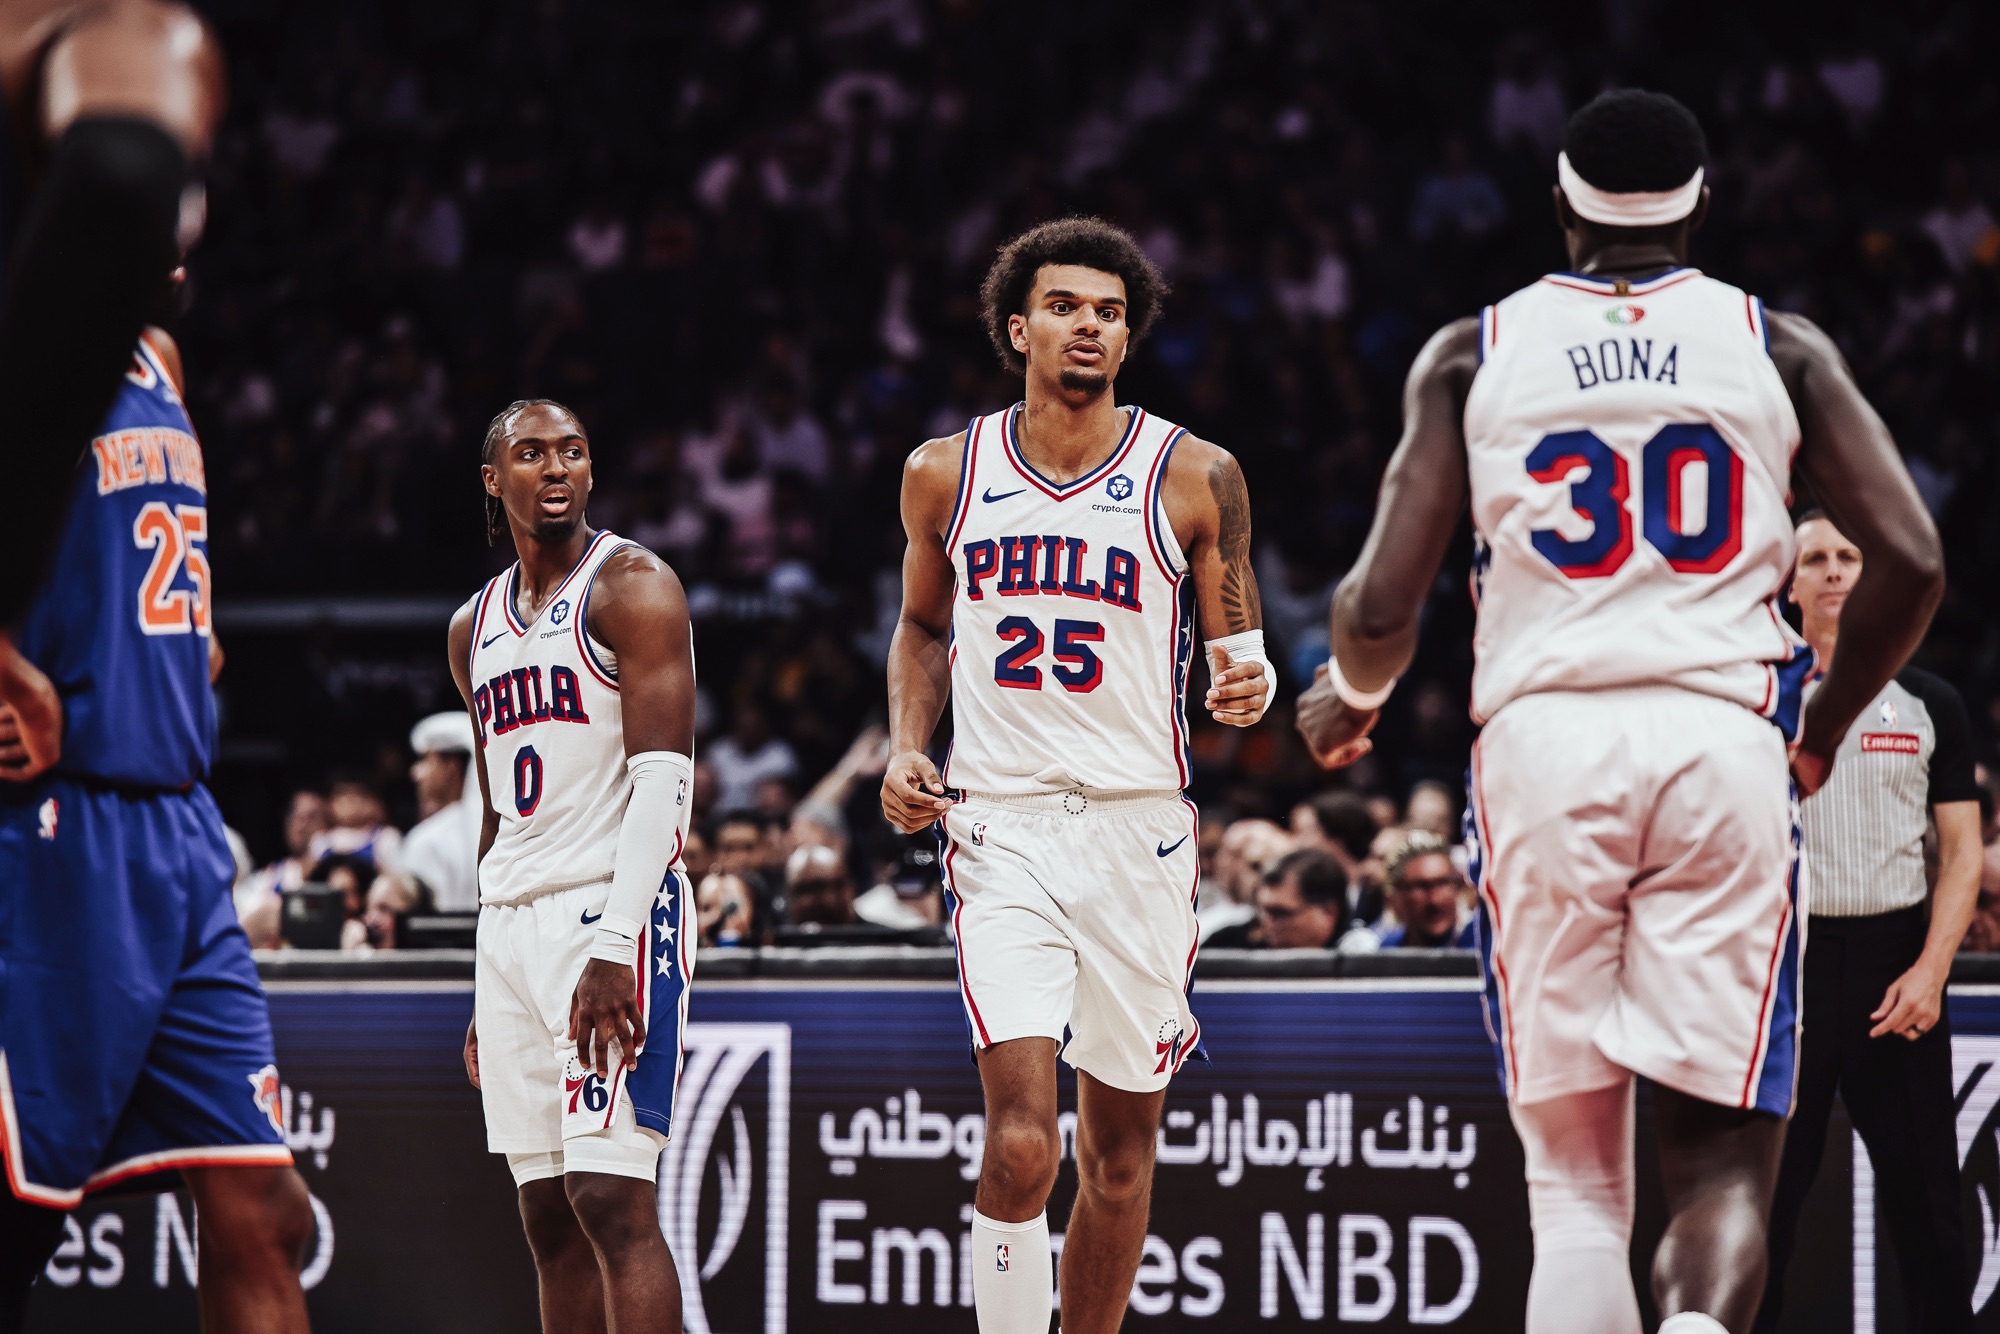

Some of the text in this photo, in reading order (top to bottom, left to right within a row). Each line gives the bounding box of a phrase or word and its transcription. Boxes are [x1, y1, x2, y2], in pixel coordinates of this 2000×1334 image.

[1566, 338, 1679, 390] BONA
[1091, 503, 1142, 515] crypto.com
[1525, 422, 1745, 579] 30
[133, 501, 211, 636] 25
[963, 535, 1143, 613] PHILA
[540, 626, 572, 640] crypto.com
[994, 615, 1105, 693] 25
[473, 664, 590, 749] PHILA
[1862, 734, 1919, 751] Emirates
[514, 744, 543, 817] 0
[565, 1072, 609, 1115] 76
[1360, 1094, 1477, 1189] بنك
[815, 1200, 1480, 1325] Emies NBD
